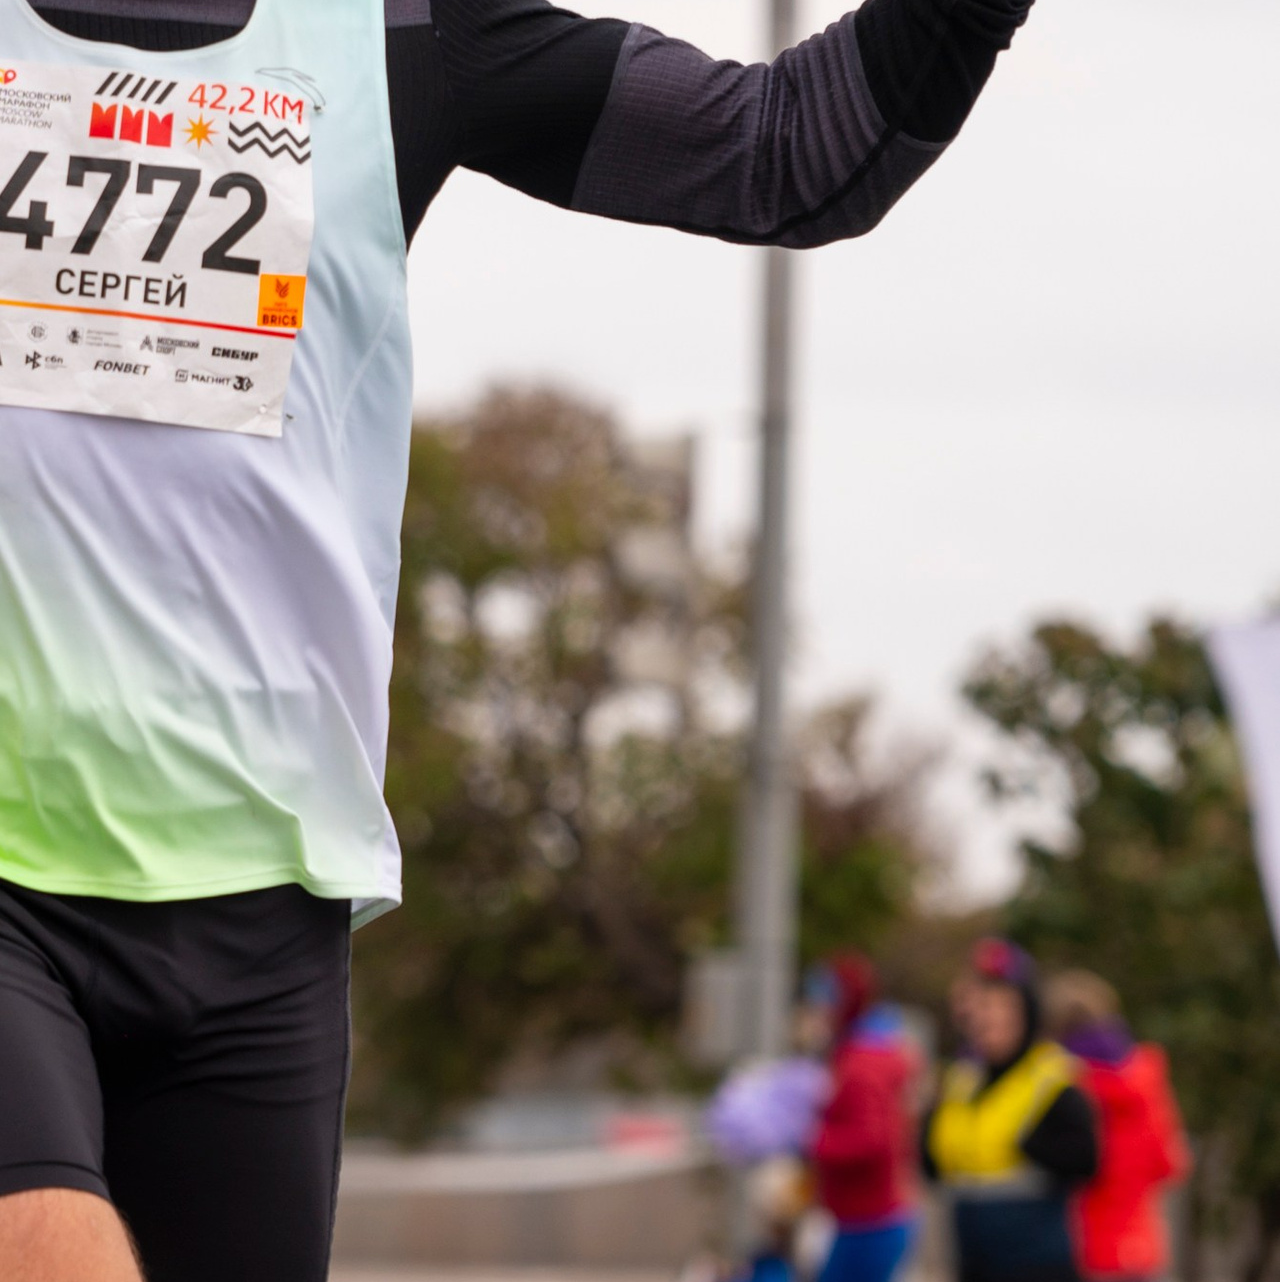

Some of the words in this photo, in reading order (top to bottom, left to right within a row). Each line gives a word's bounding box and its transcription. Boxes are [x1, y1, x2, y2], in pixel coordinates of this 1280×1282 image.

[187, 83, 255, 115] 42,2
[263, 90, 304, 124] КМ
[55, 268, 187, 308] СЕРГЕЙ
[262, 314, 298, 327] BRICS
[211, 346, 259, 362] СИБУР
[93, 359, 151, 376] FONBET
[191, 373, 231, 386] МАГНИТ
